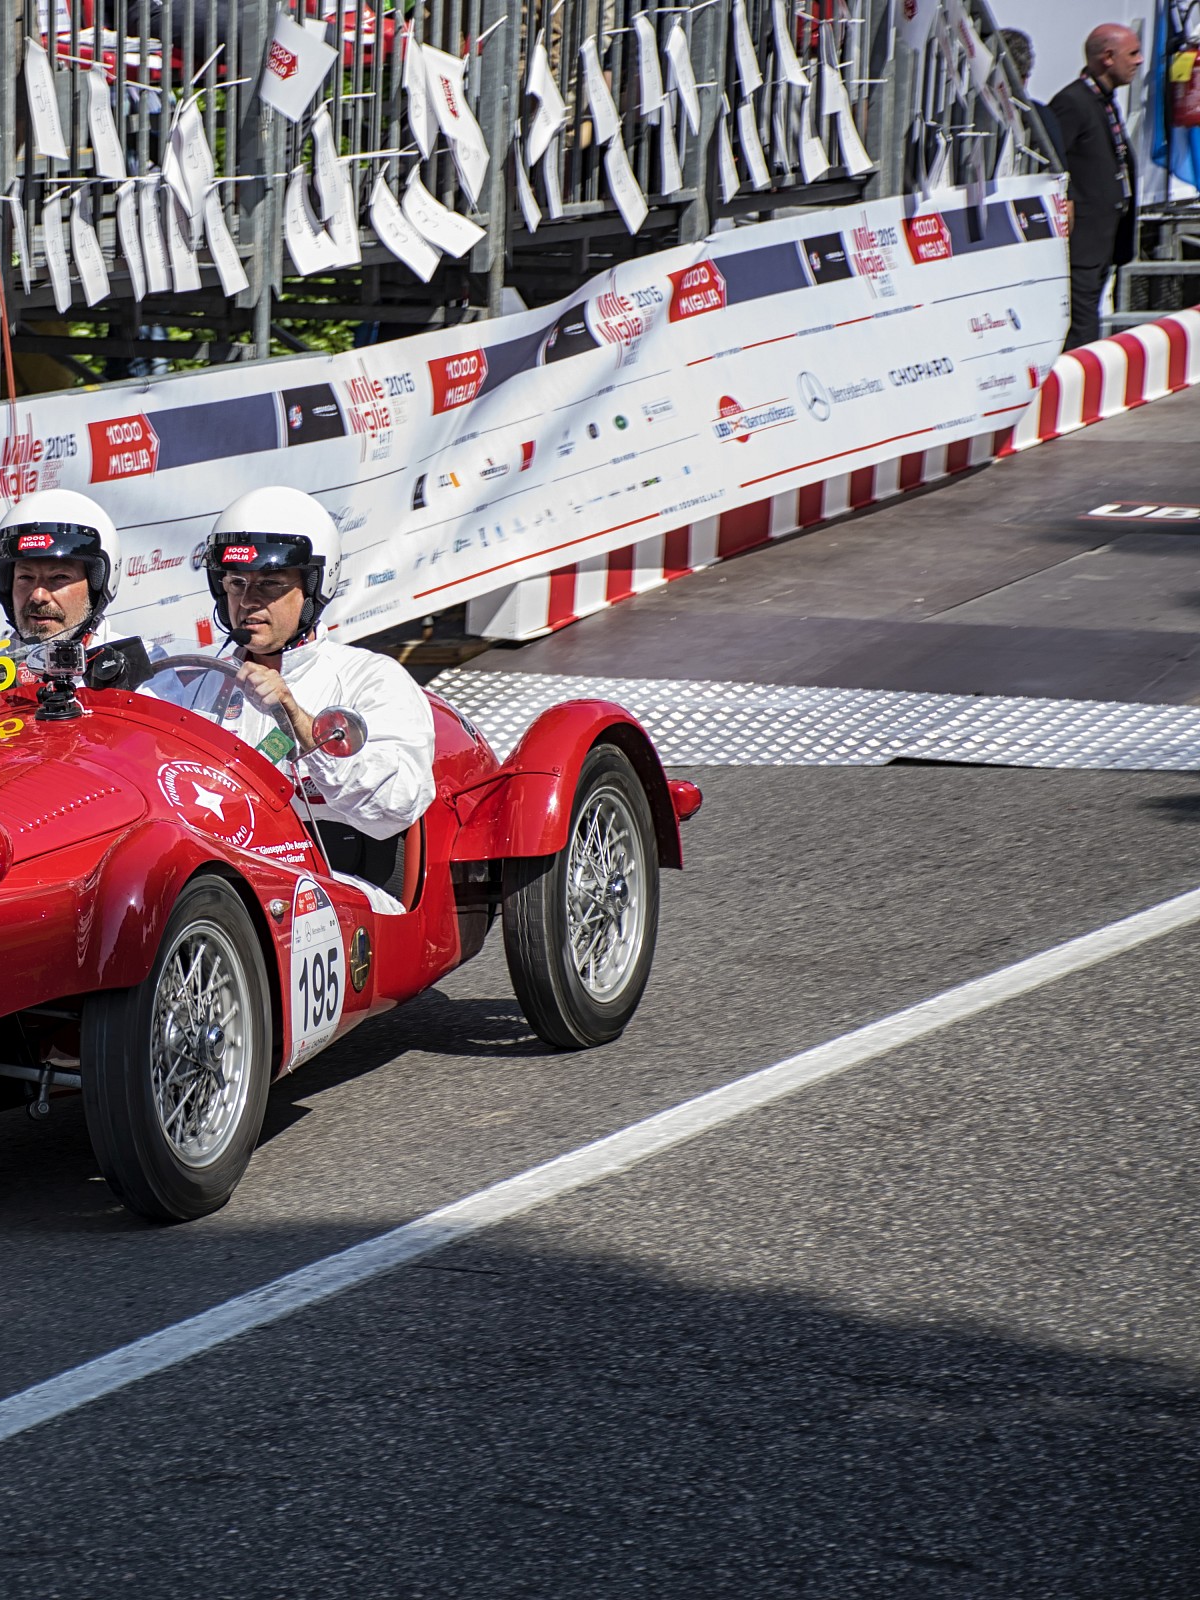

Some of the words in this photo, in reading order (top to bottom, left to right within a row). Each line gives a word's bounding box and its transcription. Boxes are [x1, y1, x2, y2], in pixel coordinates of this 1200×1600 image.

[596, 271, 633, 319] Mille
[630, 285, 664, 308] 2015
[680, 288, 721, 315] MIGLIA
[446, 355, 479, 380] 1000
[888, 357, 954, 387] CHOPARD
[343, 357, 385, 406] Mille
[383, 372, 416, 398] 2015
[444, 381, 477, 408] MIGLIA
[0, 412, 45, 467] Mille
[44, 434, 78, 461] 2015
[106, 421, 143, 446] 1000
[108, 448, 152, 476] MIGLIA
[1087, 503, 1200, 519] UB
[126, 556, 150, 585] Alfa
[148, 549, 188, 572] Romeo
[20, 670, 36, 679] 201
[165, 767, 184, 808] SQUADRA
[174, 764, 237, 792] TARASCHI
[213, 825, 248, 845] RAMO
[260, 843, 287, 855] Giuseppe
[285, 841, 295, 852] De
[286, 853, 306, 863] Girardi
[298, 947, 339, 1032] 195
